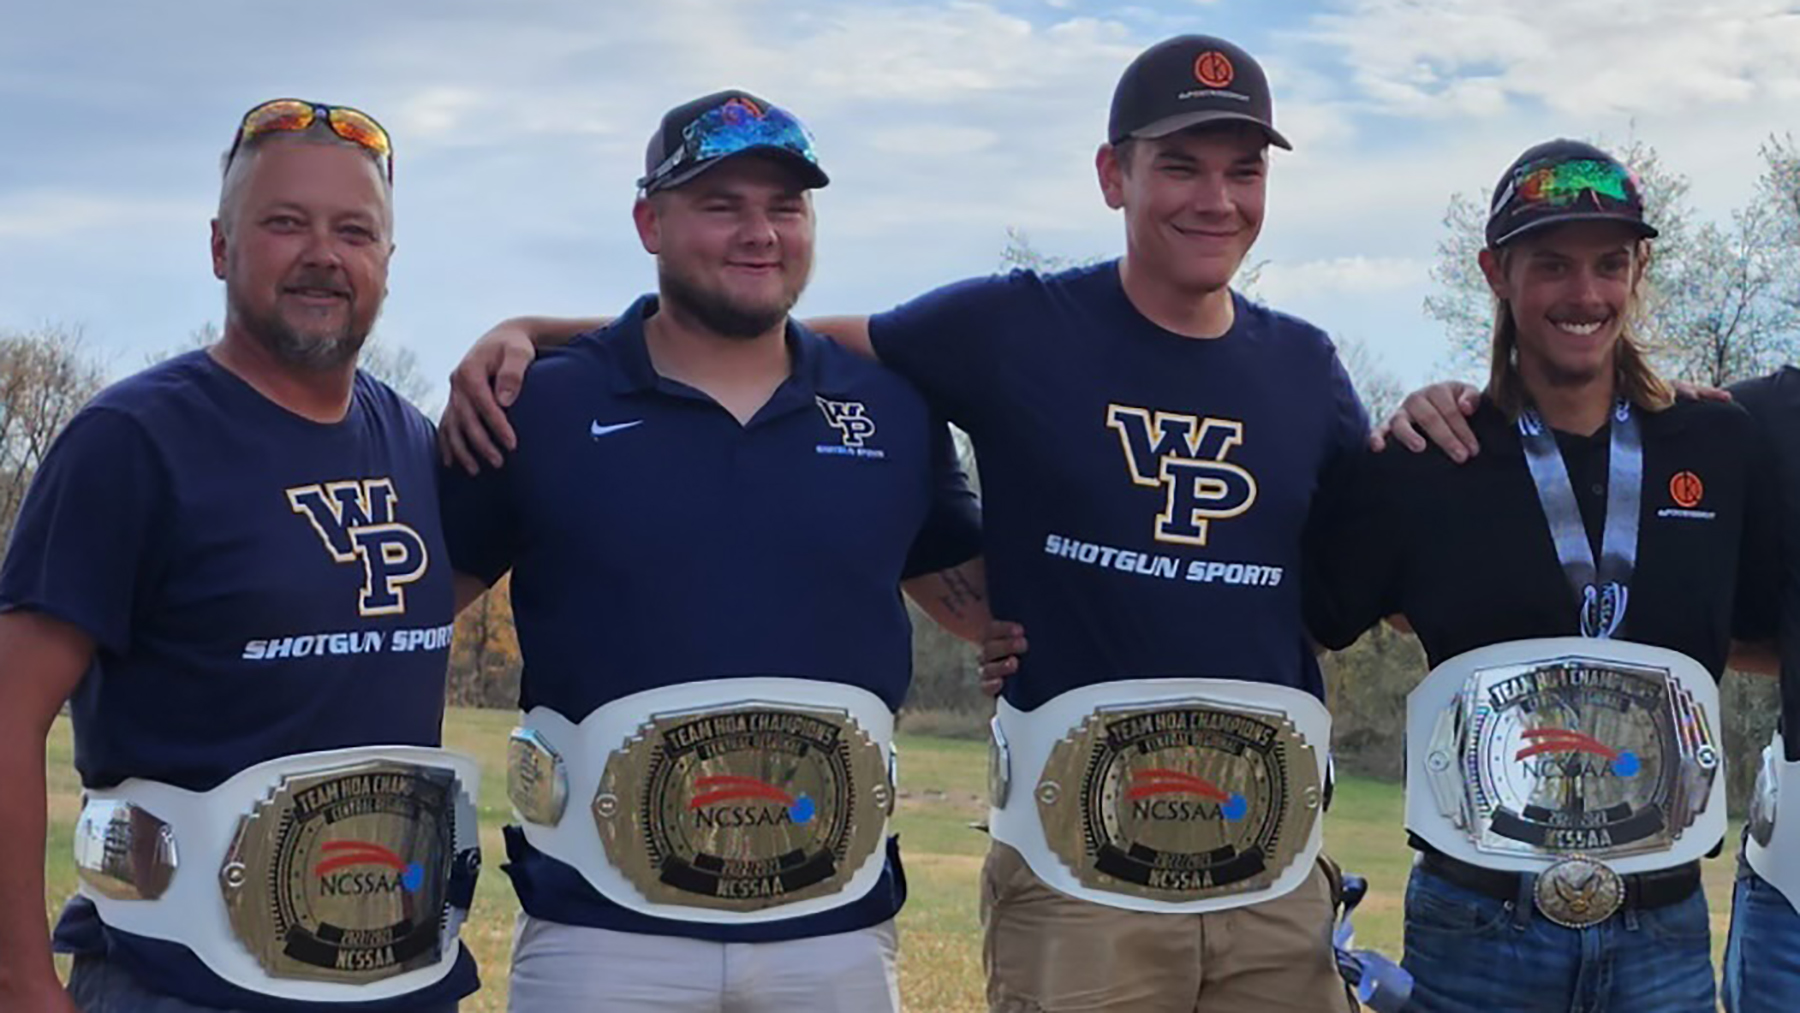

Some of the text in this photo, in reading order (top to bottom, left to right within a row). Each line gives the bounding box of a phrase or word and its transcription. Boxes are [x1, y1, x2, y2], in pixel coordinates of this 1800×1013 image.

[1106, 403, 1257, 546] WP
[286, 477, 428, 616] WP
[1044, 534, 1284, 587] SHOTGUN SPORTS
[242, 624, 454, 660] SHOTGUN SPORT
[668, 719, 713, 749] TEAM
[714, 714, 747, 736] HOA
[750, 713, 837, 746] CHAMPIONS
[1109, 717, 1154, 743] TEAM
[1155, 713, 1187, 731] HOA
[1190, 711, 1274, 746] CHAMPIONS
[297, 782, 340, 814] TEAM
[341, 775, 372, 799] HOA
[1132, 799, 1225, 821] NCSSAA
[695, 806, 792, 827] NCSSAA
[320, 872, 405, 896] NCSSAA
[716, 875, 785, 898] NCSSAA
[1147, 868, 1215, 890] NCSSAA
[335, 944, 396, 971] NCSSAA
